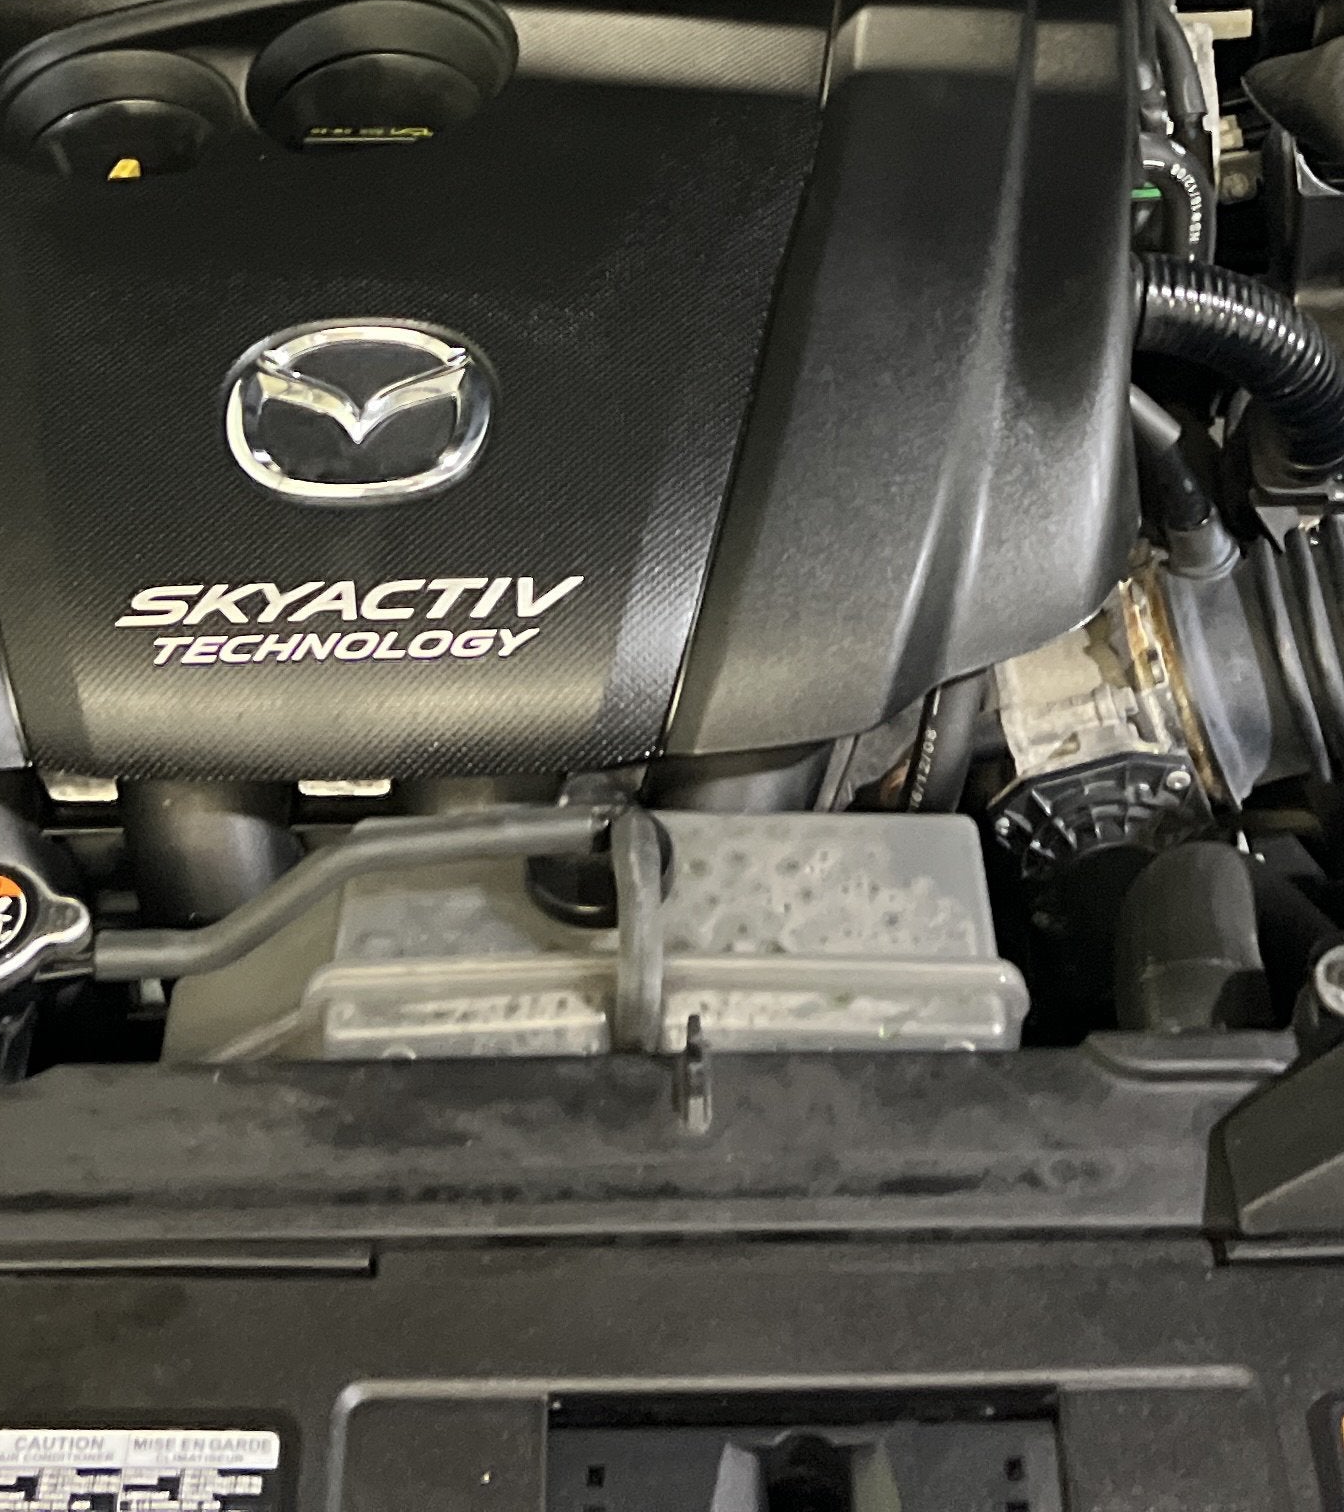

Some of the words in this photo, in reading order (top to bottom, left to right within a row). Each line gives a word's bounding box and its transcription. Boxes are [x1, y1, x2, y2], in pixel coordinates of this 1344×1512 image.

[114, 574, 585, 628] SKYACTIV
[153, 628, 540, 666] TECHNOLOGY
[14, 1435, 105, 1451] CAUTION
[133, 1436, 176, 1451] MISE
[180, 1437, 205, 1452] EN
[209, 1437, 273, 1454] GARDE
